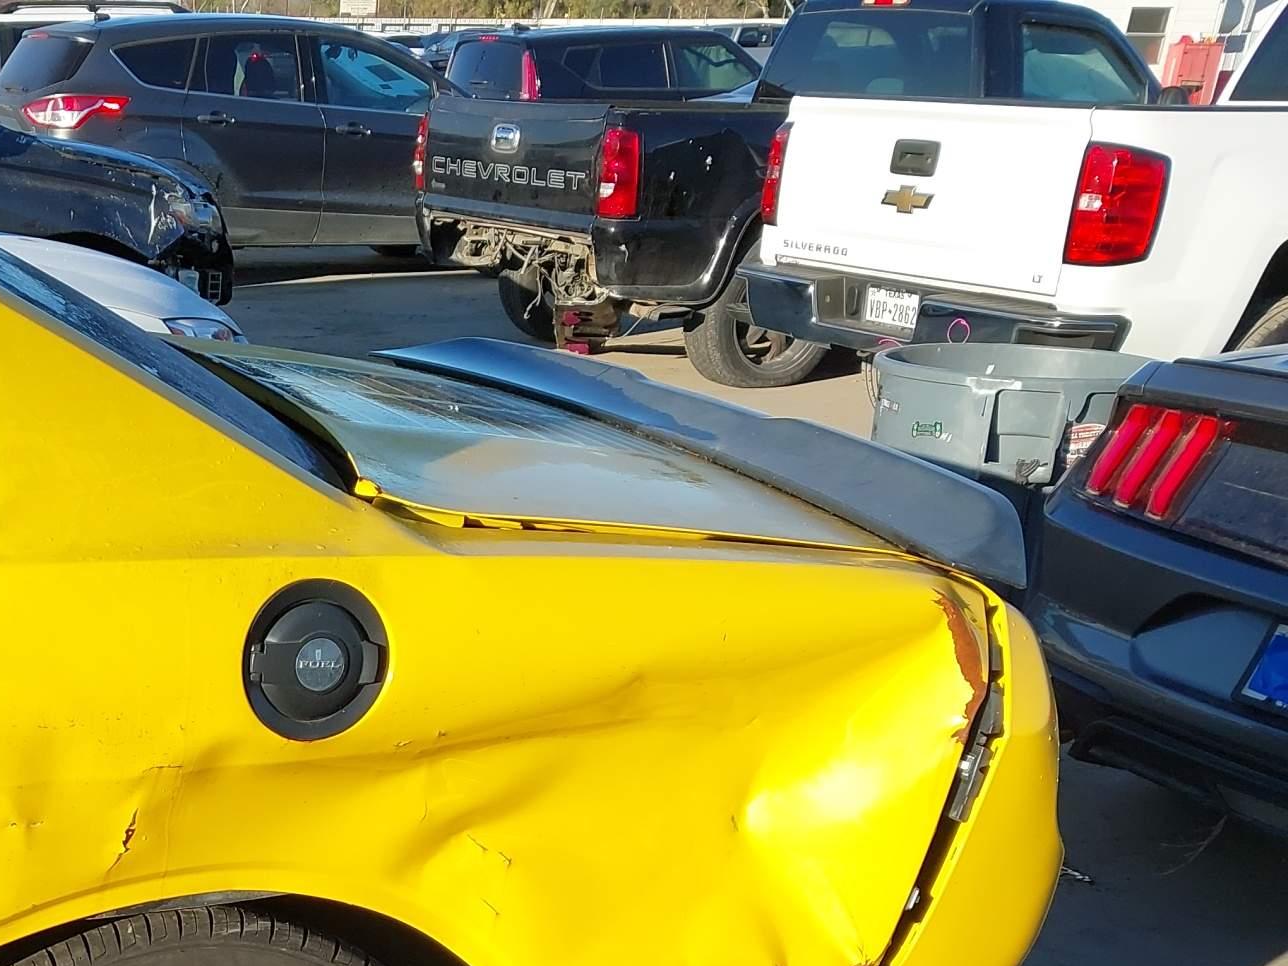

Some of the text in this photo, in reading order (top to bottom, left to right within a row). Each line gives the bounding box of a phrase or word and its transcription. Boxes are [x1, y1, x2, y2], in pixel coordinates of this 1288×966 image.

[431, 155, 586, 190] CHEVROLET
[782, 239, 849, 257] SILVERADO
[1031, 274, 1044, 284] LT
[298, 659, 343, 669] FUEL
